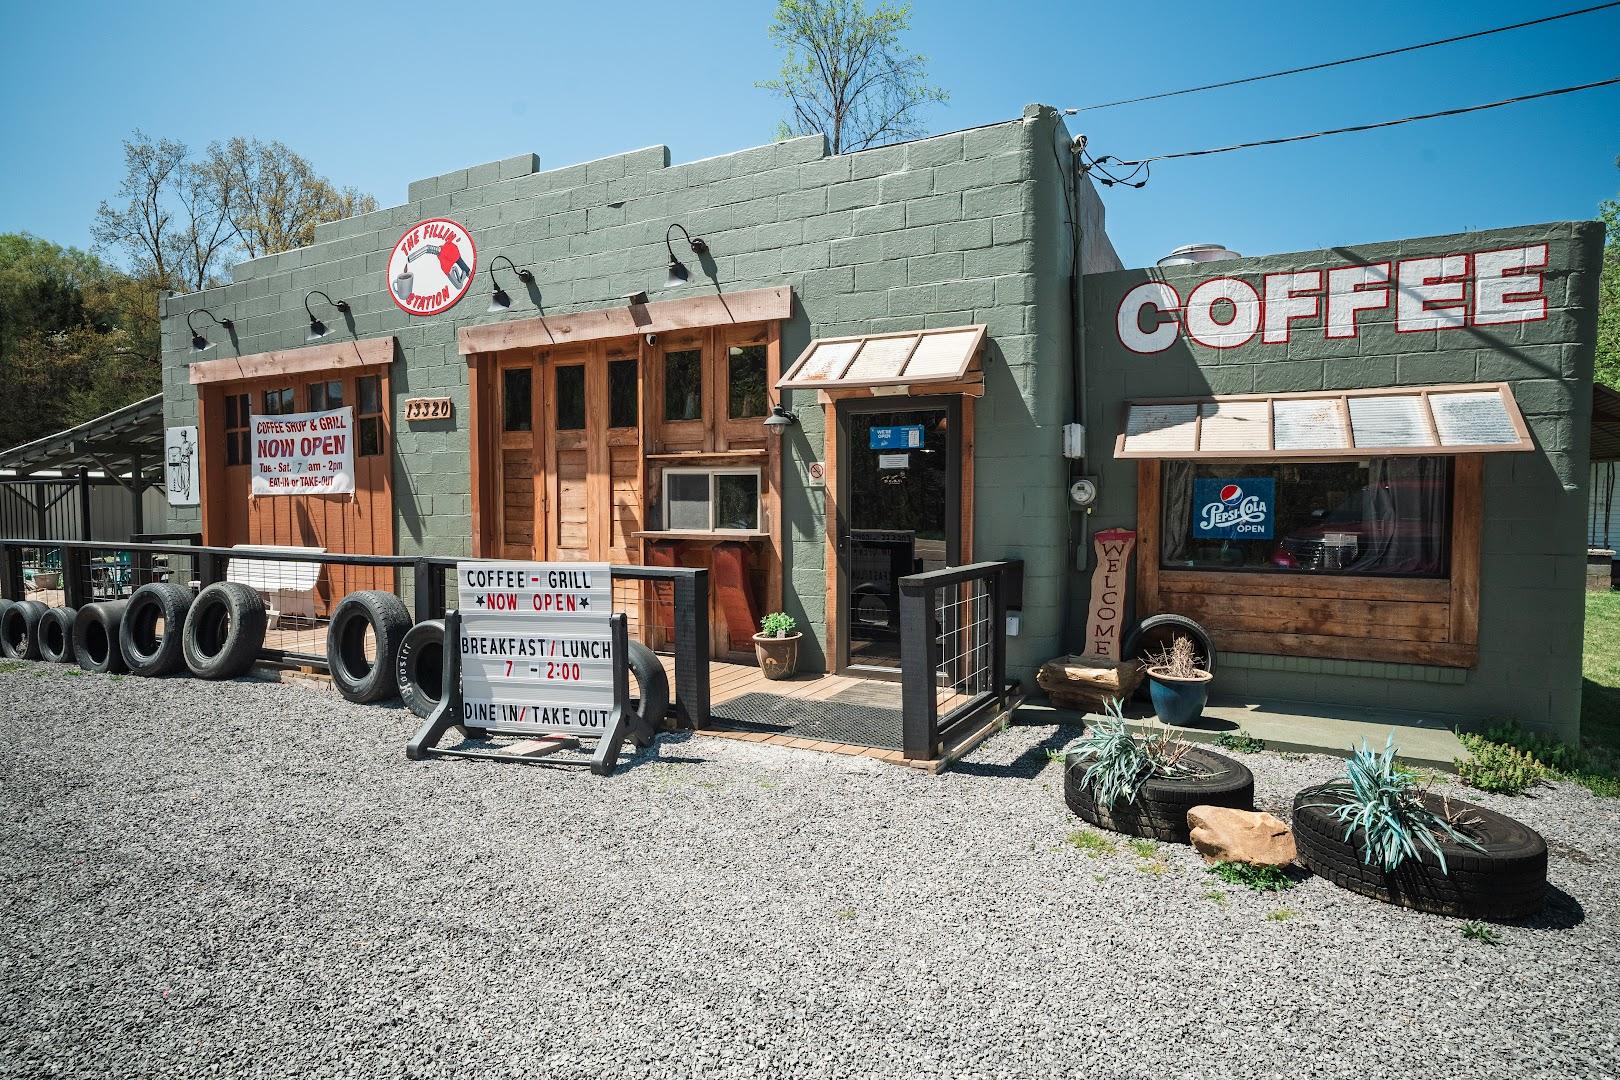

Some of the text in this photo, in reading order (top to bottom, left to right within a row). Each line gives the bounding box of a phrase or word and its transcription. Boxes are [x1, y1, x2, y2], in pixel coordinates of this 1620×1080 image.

[401, 229, 420, 257] THE
[406, 285, 450, 310] STATION
[1116, 243, 1550, 354] COFFEE
[406, 401, 449, 418] 13320
[257, 416, 346, 434] COFFEE SHOP & GRILL
[258, 435, 345, 458] NOW OPEN
[309, 463, 321, 472] am
[329, 460, 343, 473] 2pm
[300, 475, 334, 487] TAKE-OUT
[1237, 525, 1265, 533] OPEN
[467, 570, 525, 588] COFFEE
[548, 571, 591, 589] GRILL
[487, 593, 576, 612] NOW OPEN
[1094, 543, 1125, 656] WELCOME
[505, 660, 513, 677] 7
[546, 662, 580, 681] 2:00
[464, 702, 496, 721] DINE
[532, 706, 571, 725] TAKE
[578, 710, 608, 728] OUT
